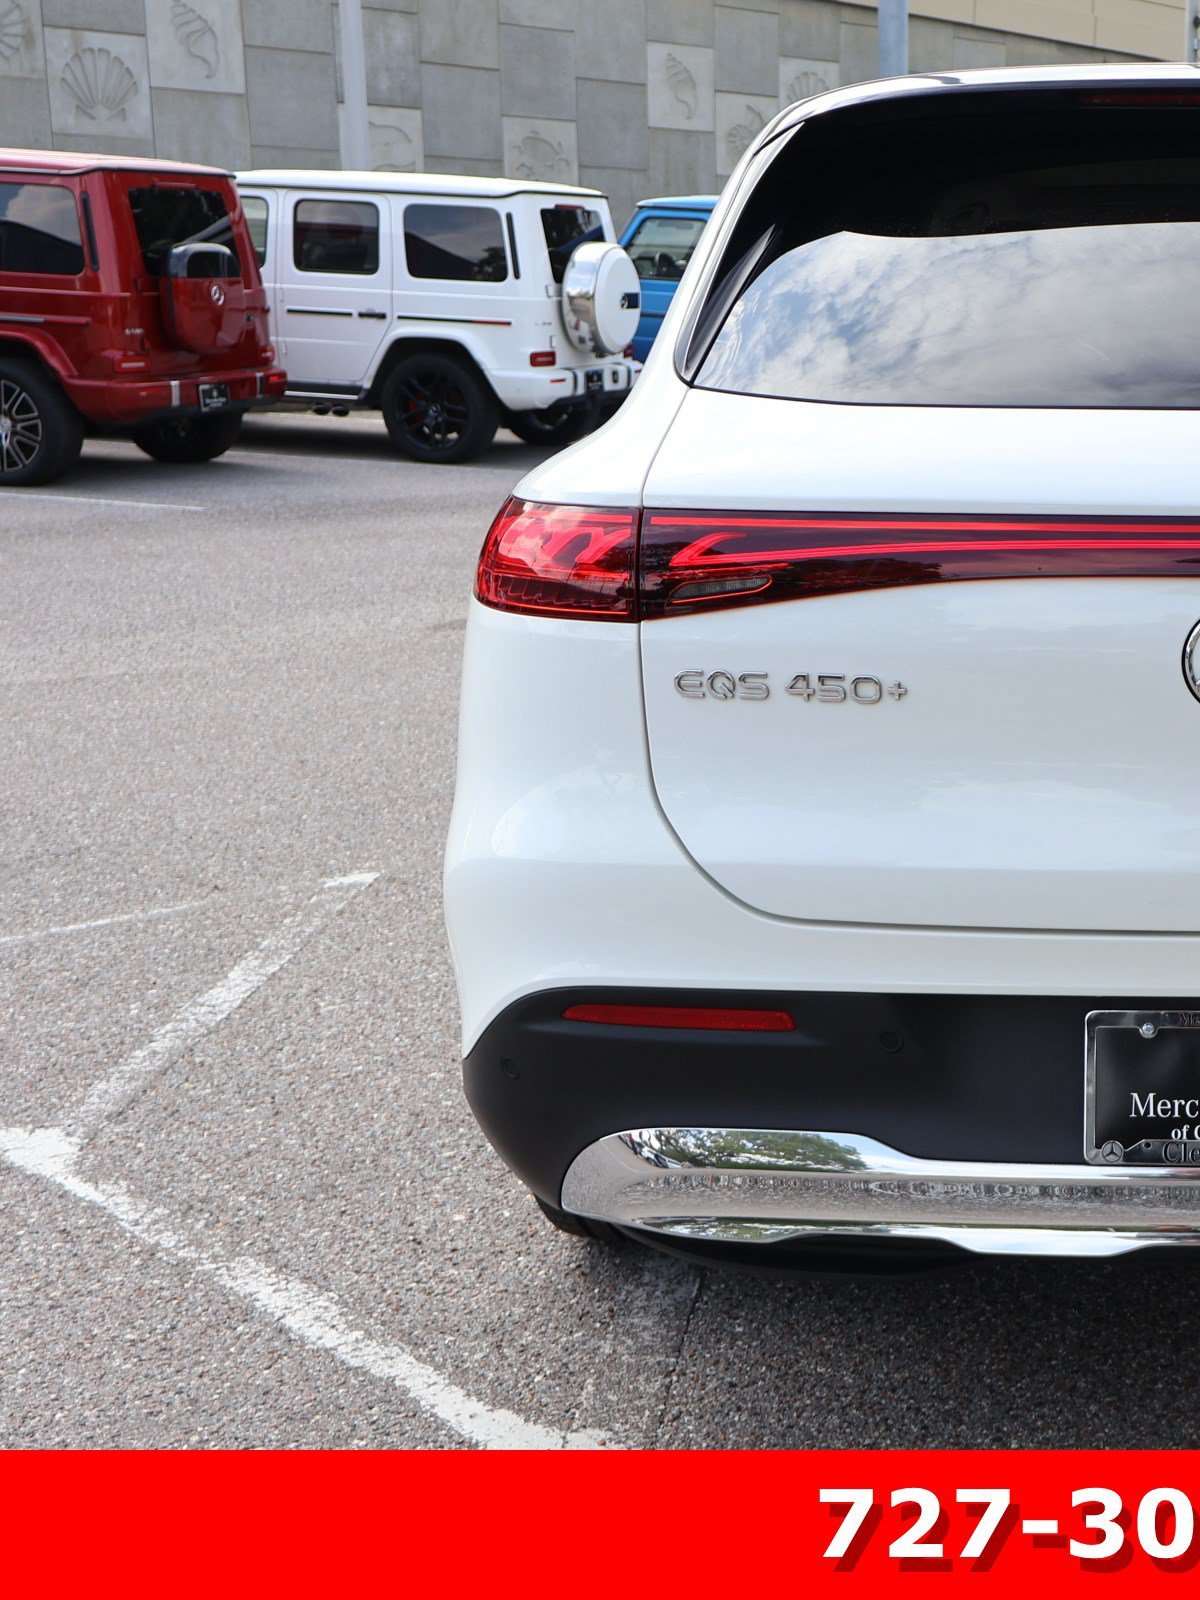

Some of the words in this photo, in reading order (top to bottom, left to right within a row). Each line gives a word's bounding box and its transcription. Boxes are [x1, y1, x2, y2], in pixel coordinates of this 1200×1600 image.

[673, 669, 772, 700] EQS
[784, 673, 908, 704] 450+
[1170, 1124, 1190, 1140] of
